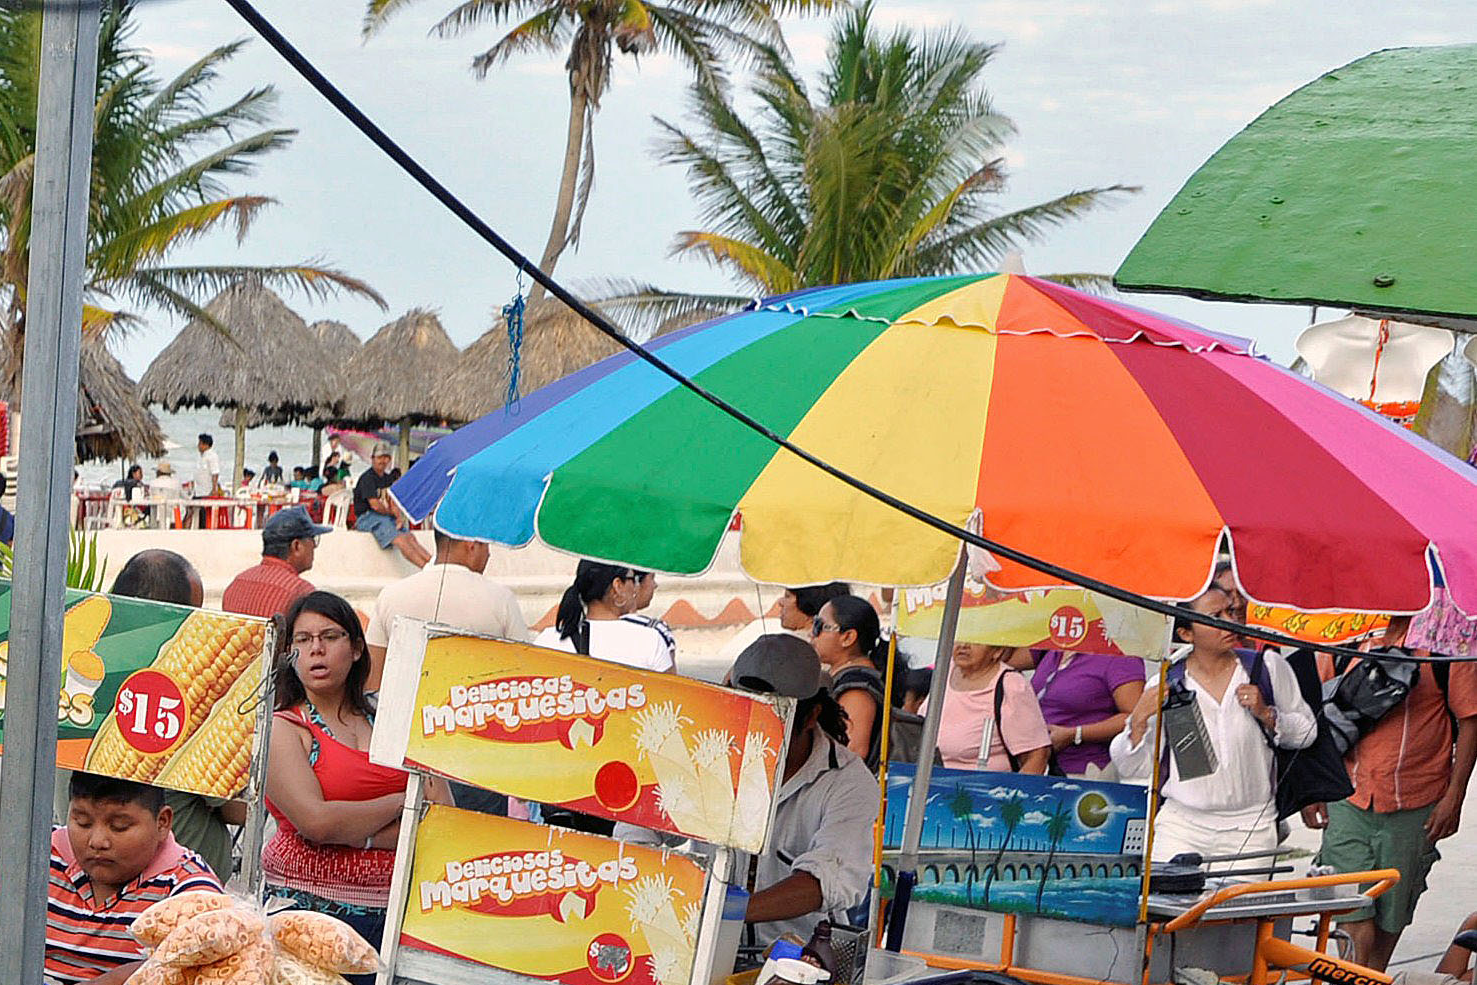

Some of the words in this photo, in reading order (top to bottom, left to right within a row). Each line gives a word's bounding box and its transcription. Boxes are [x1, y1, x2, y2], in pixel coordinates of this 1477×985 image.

[1050, 614, 1084, 639] $15
[450, 675, 573, 708] Deliciosas
[118, 687, 181, 739] $15
[445, 849, 564, 883] Deliciosas
